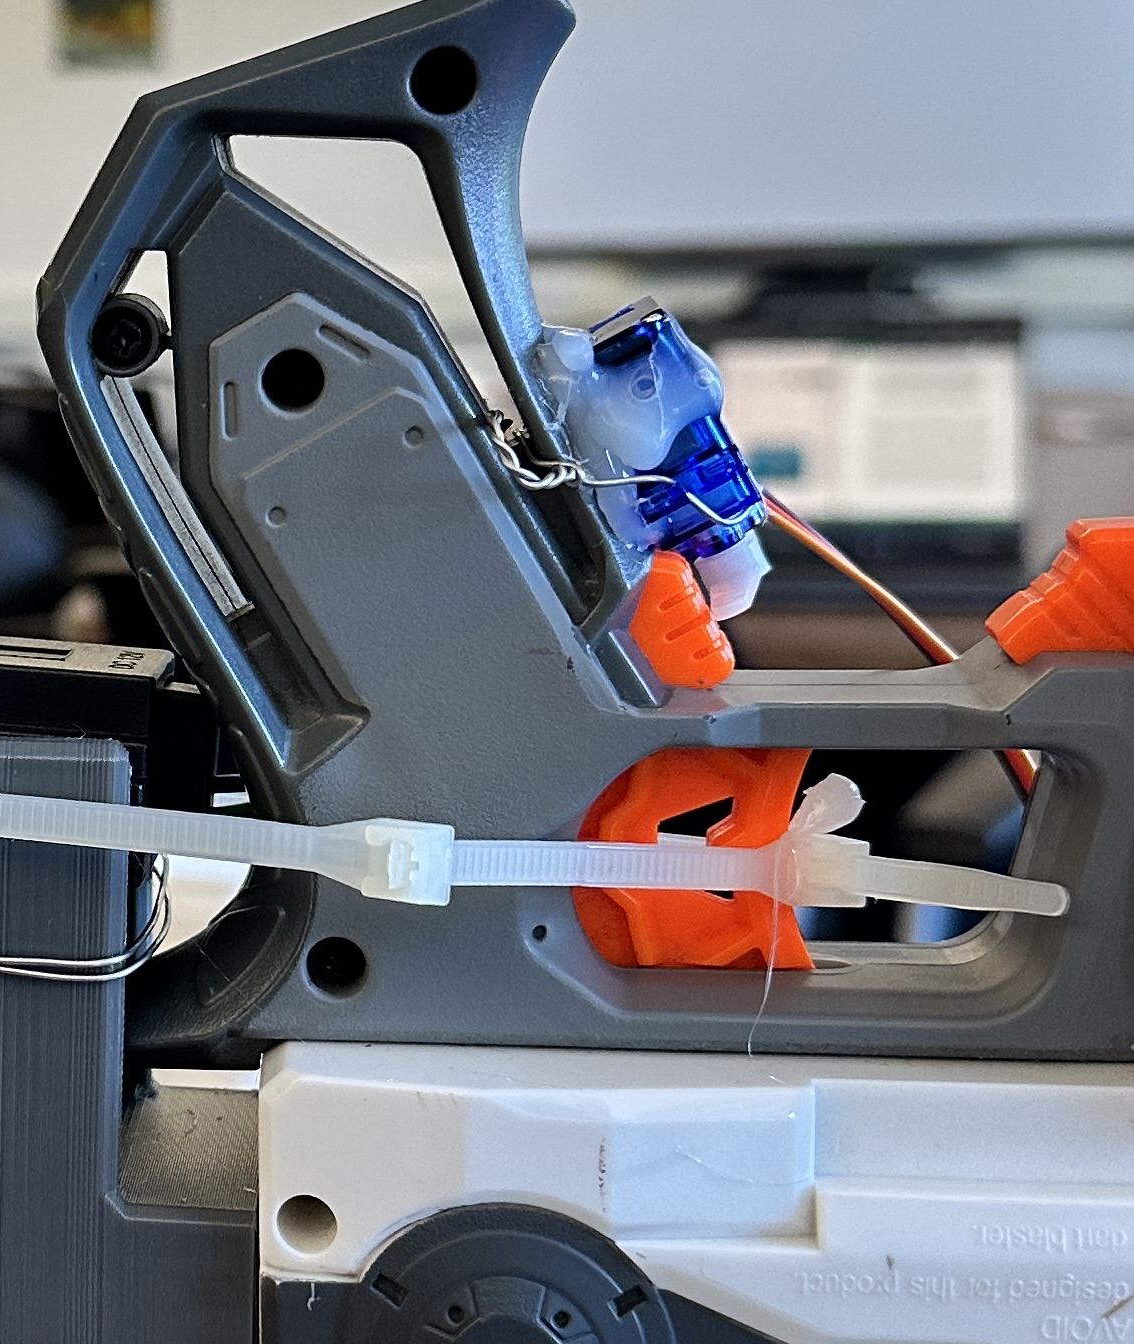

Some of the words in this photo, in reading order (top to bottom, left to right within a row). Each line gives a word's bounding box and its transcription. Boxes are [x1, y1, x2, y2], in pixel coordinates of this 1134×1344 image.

[971, 1224, 1066, 1256] blaster.
[1072, 1227, 1128, 1255] dart
[794, 1270, 899, 1298] product.
[908, 1276, 957, 1303] this
[969, 1278, 1002, 1304] for
[1009, 1273, 1130, 1305] designed
[1040, 1316, 1134, 1343] AVOID
